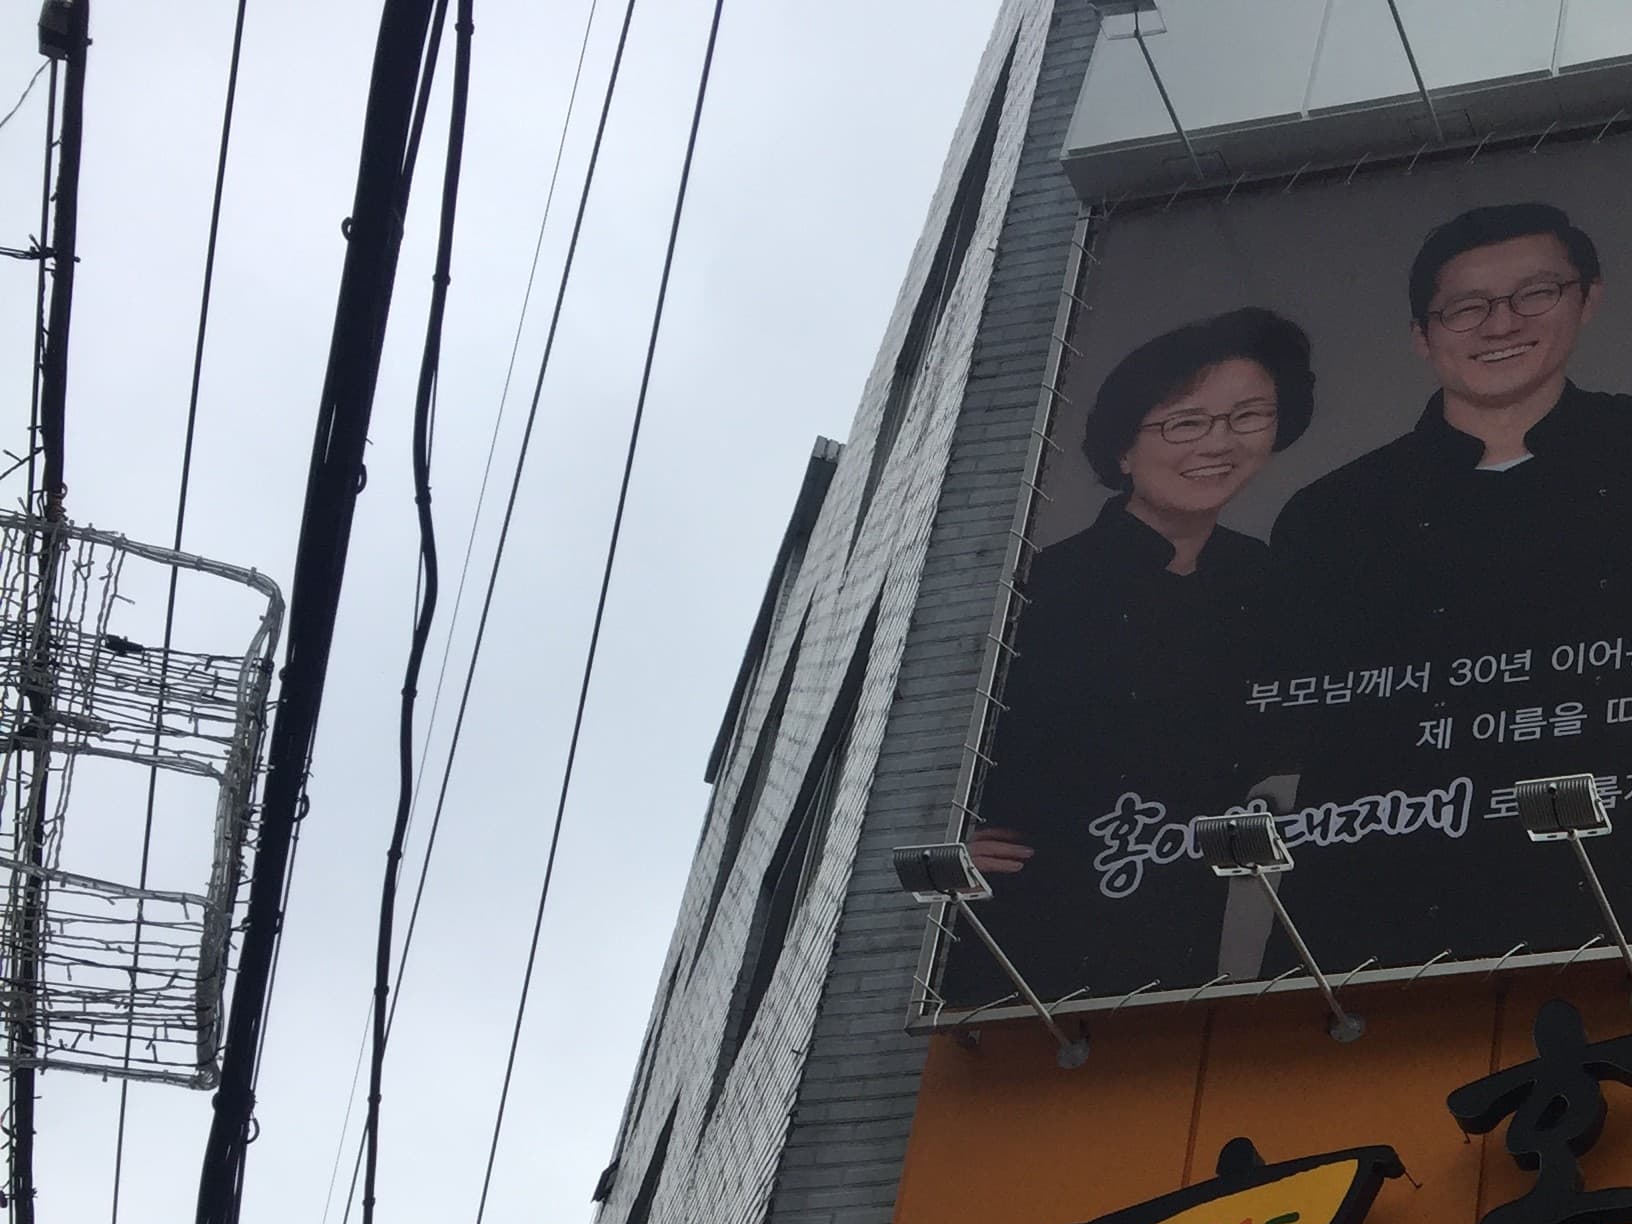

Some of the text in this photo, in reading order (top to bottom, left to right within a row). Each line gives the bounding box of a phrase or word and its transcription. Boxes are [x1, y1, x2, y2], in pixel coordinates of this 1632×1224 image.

[1245, 661, 1431, 713] 부모님께서
[1449, 649, 1532, 687] 30년
[1416, 717, 1453, 750] 제
[1472, 701, 1588, 743] 이름을
[1088, 776, 1473, 899] 홍이대찌개
